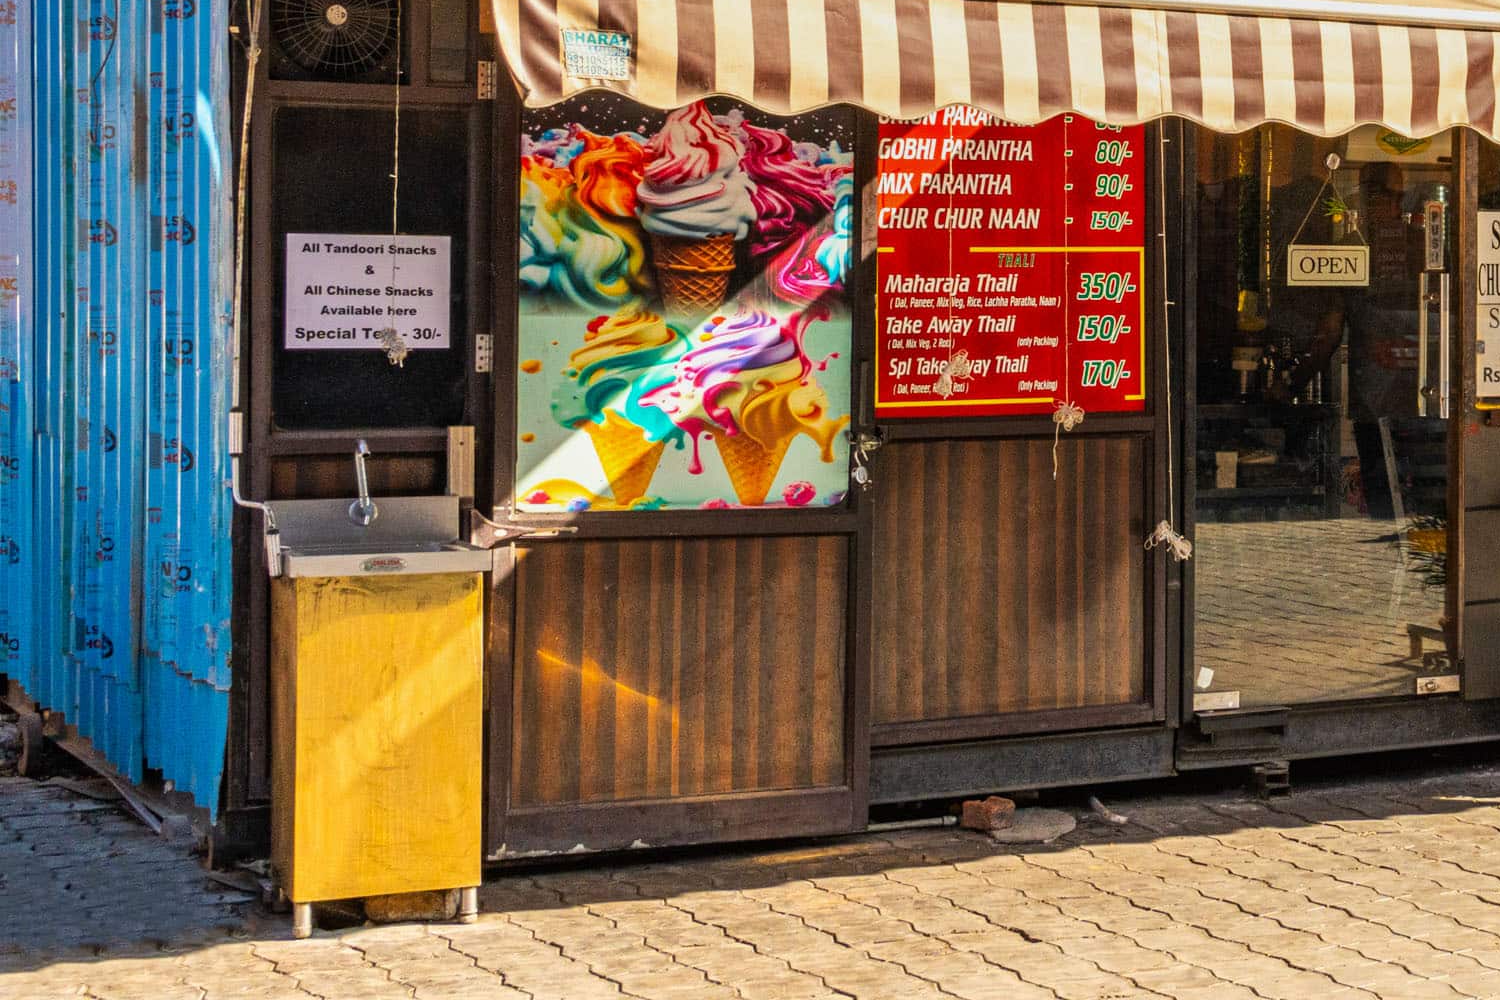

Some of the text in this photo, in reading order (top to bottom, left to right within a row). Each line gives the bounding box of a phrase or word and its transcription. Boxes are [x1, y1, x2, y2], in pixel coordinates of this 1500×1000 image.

[879, 137, 1132, 166] GOBHI PARANTHA 80/-
[878, 172, 1132, 199] MIX PARANTHA 90/-
[878, 207, 1132, 232] CHUR CHUR NAAN 150/-
[302, 243, 437, 256] All Tandoori Snacks
[997, 253, 1035, 268] THALI
[1299, 257, 1359, 274] OPEN
[364, 264, 375, 275] &
[304, 285, 434, 297] All Chinese Snacks
[885, 272, 1136, 302] Maharaja Thali 350/-
[320, 305, 417, 316] Available here
[295, 327, 442, 341] Special Te 30/-
[886, 315, 1131, 344] Take Away Thali 150/-
[888, 357, 912, 379] Spl
[916, 357, 947, 375] Take
[995, 355, 1030, 373] Thali
[1081, 359, 1130, 388] 170/-
